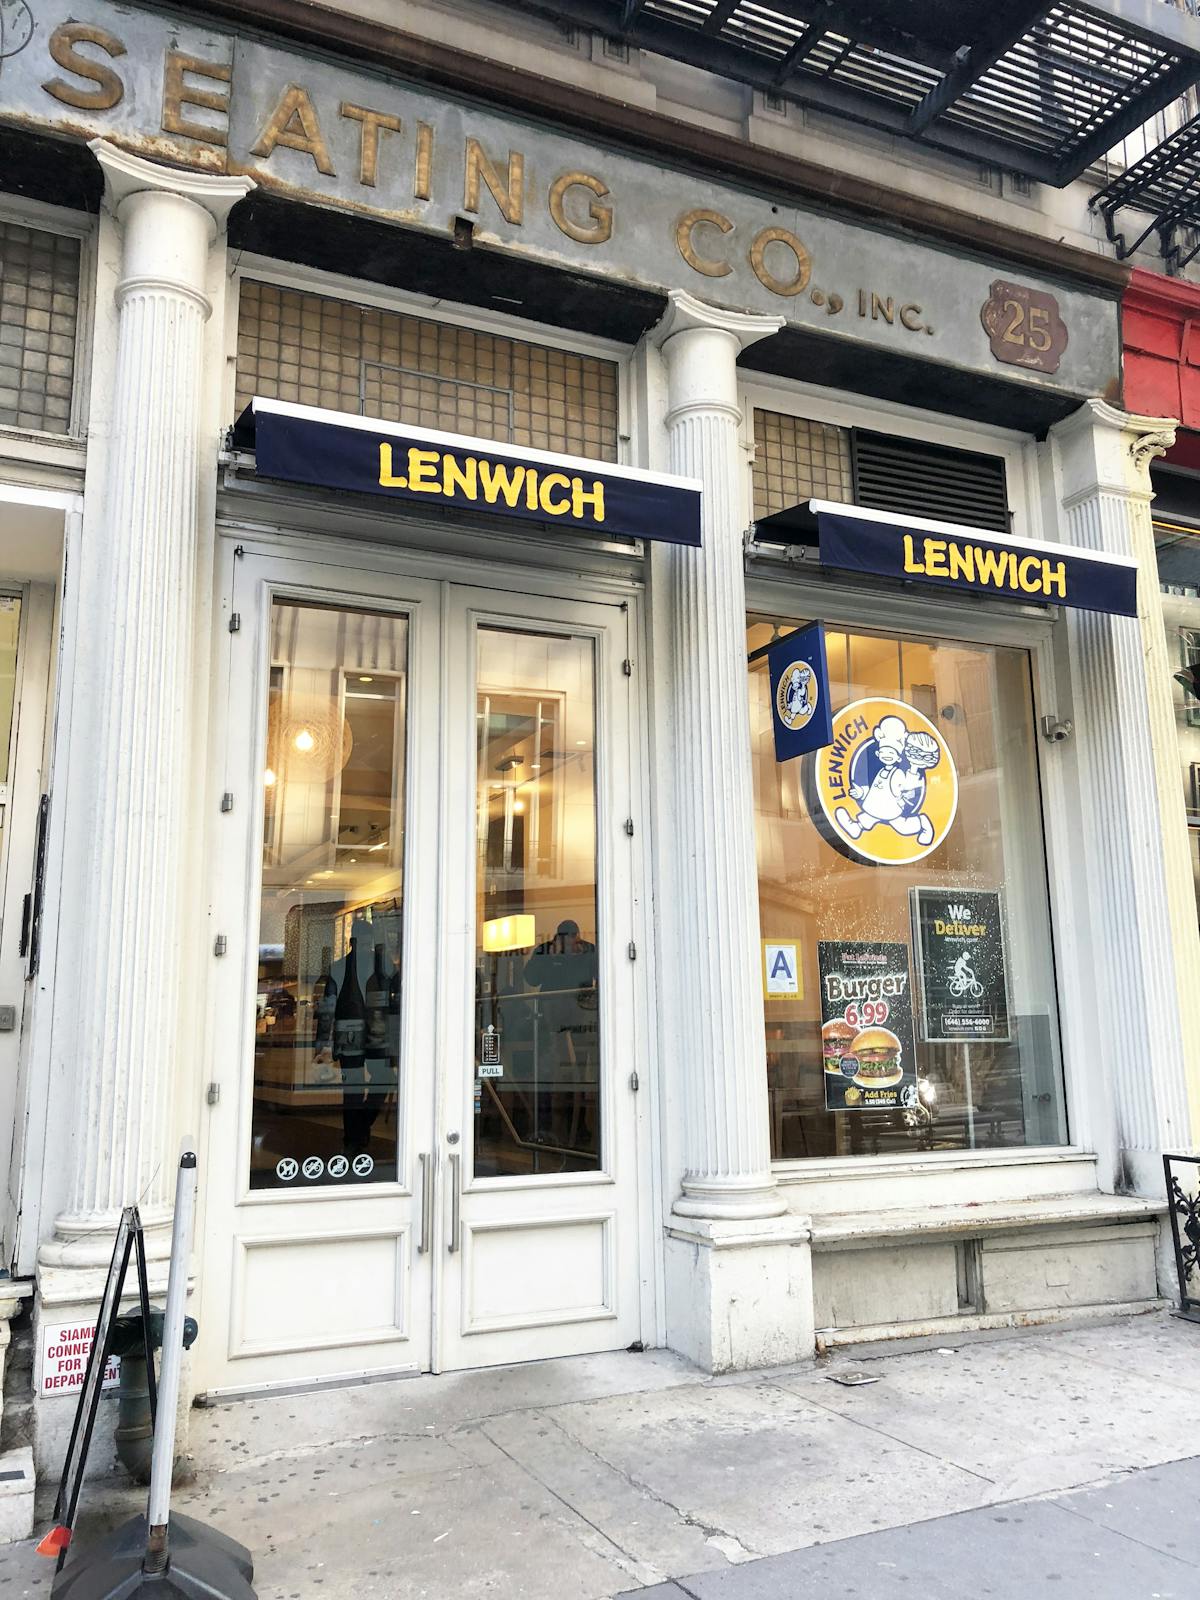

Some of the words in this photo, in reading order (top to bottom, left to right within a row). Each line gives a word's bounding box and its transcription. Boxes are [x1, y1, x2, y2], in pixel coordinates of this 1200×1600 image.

[41, 22, 613, 245] SEATING
[1002, 300, 1053, 352] 25
[379, 443, 604, 522] LENWICH
[903, 535, 1067, 598] LENWICH
[780, 675, 790, 715] LENWICH
[829, 715, 869, 801] LENWICH
[947, 904, 972, 920] We
[934, 920, 987, 936] Deliver
[770, 950, 793, 979] A
[826, 975, 907, 1002] Burger
[844, 1001, 889, 1027] 6.99
[482, 1067, 500, 1075] PULL
[864, 1091, 879, 1099] Add
[880, 1091, 897, 1099] Fries
[58, 1358, 82, 1372] FOR
